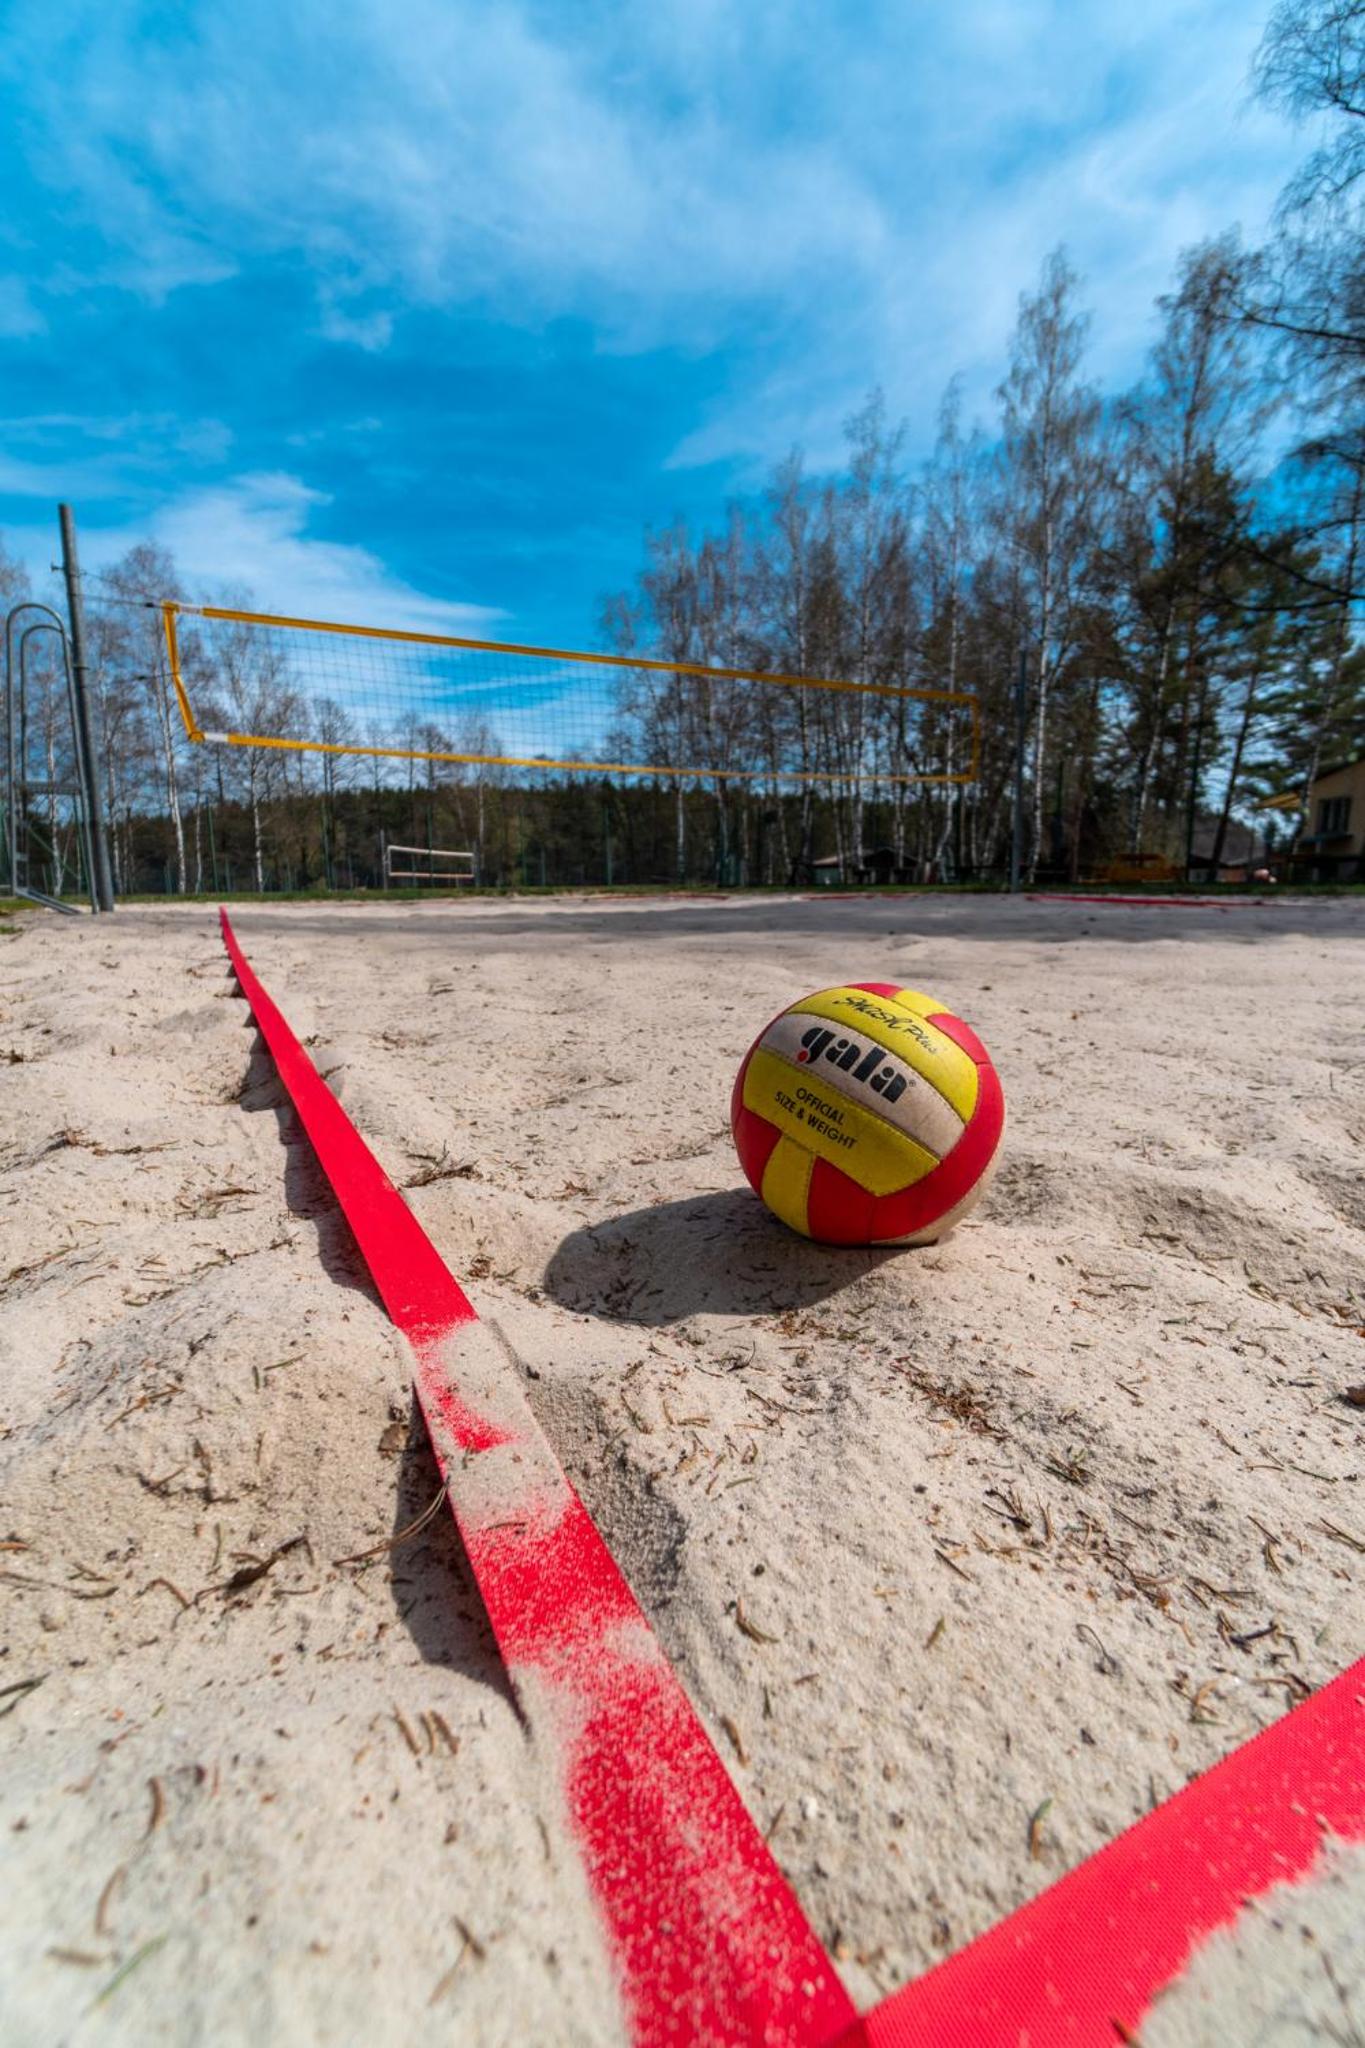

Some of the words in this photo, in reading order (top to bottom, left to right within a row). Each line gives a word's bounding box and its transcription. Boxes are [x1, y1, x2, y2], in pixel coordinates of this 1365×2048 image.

[797, 1027, 908, 1104] gala
[775, 1092, 797, 1114] SIZE
[797, 1107, 805, 1119] &
[807, 1115, 857, 1150] WEIGHT
[796, 1088, 844, 1126] OFFICIAL
